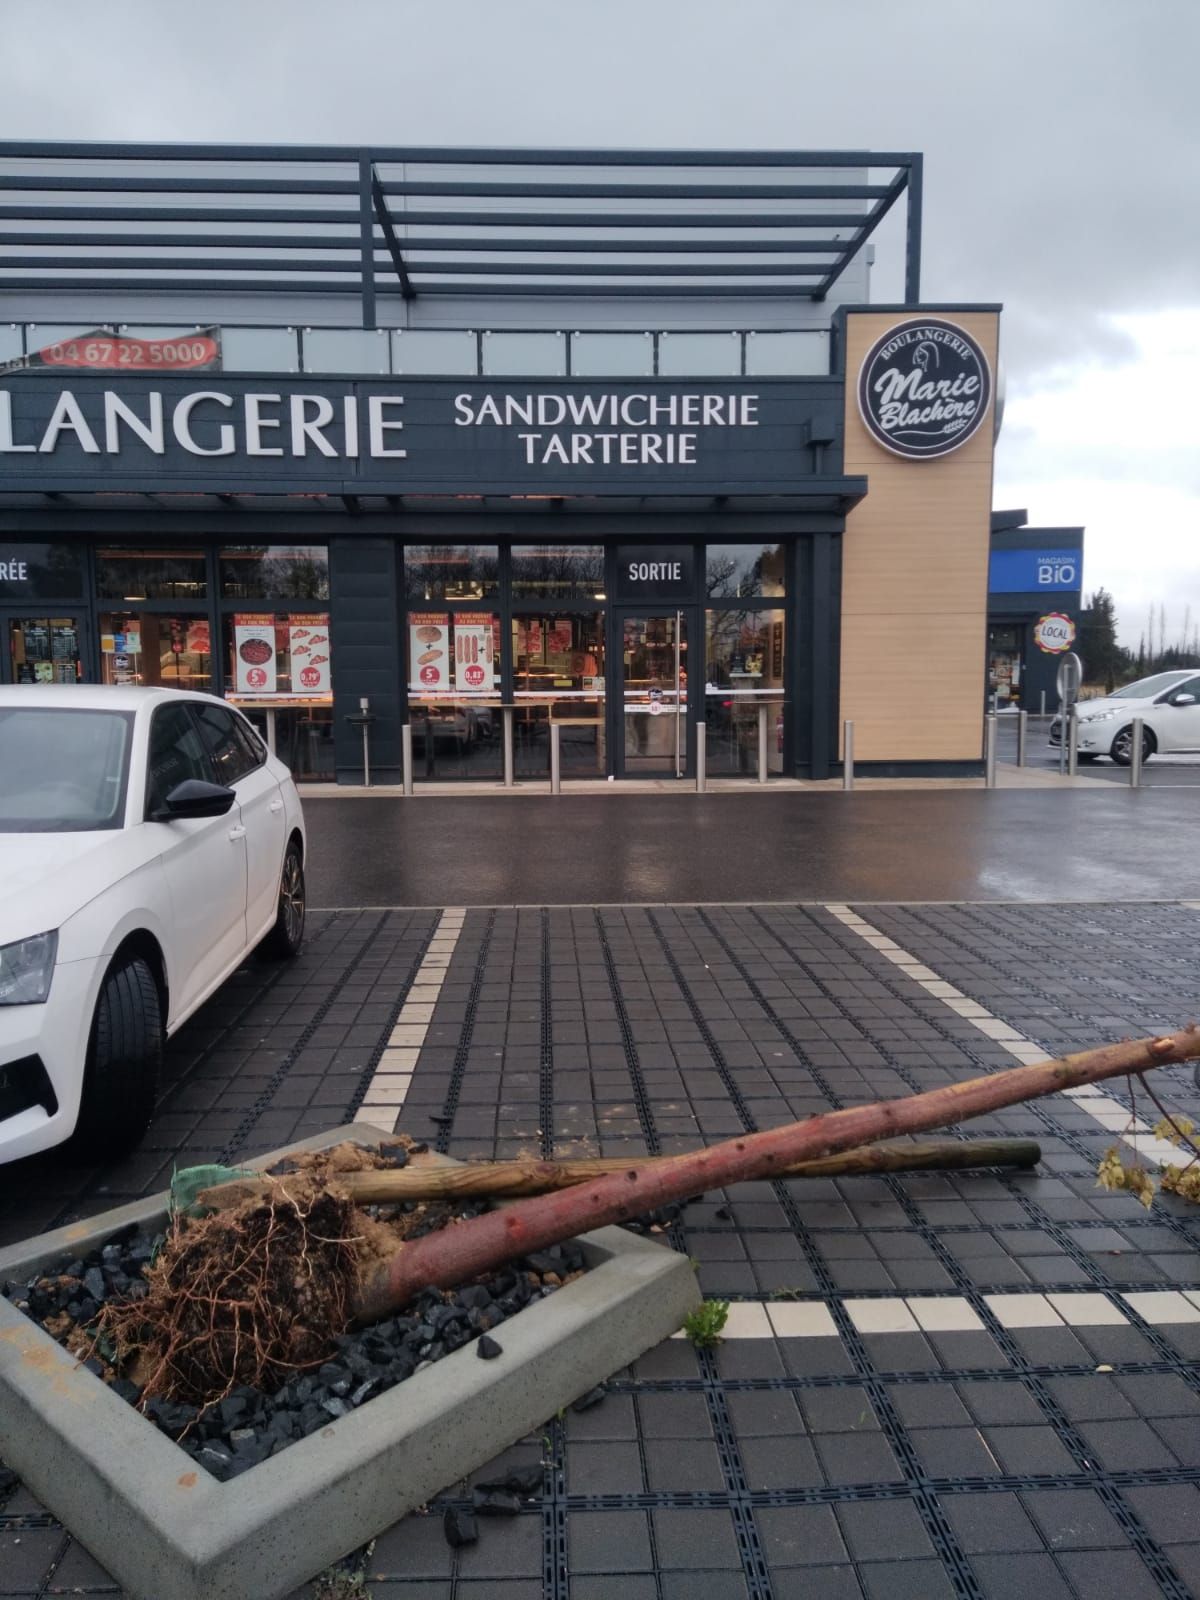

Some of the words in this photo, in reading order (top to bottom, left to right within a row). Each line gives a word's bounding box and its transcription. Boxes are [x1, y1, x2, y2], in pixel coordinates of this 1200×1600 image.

[50, 344, 79, 361] 04
[85, 343, 112, 362] 67
[118, 344, 145, 363] 22
[149, 342, 206, 364] 5000
[880, 329, 972, 361] BOULANGERIE
[874, 367, 980, 405] Marie
[0, 390, 407, 458] LANGERIE
[454, 393, 759, 426] SANDWICHERIE
[517, 433, 697, 464] TARTERIE
[628, 562, 681, 581] SORTIE
[1041, 625, 1068, 640] LOCAL
